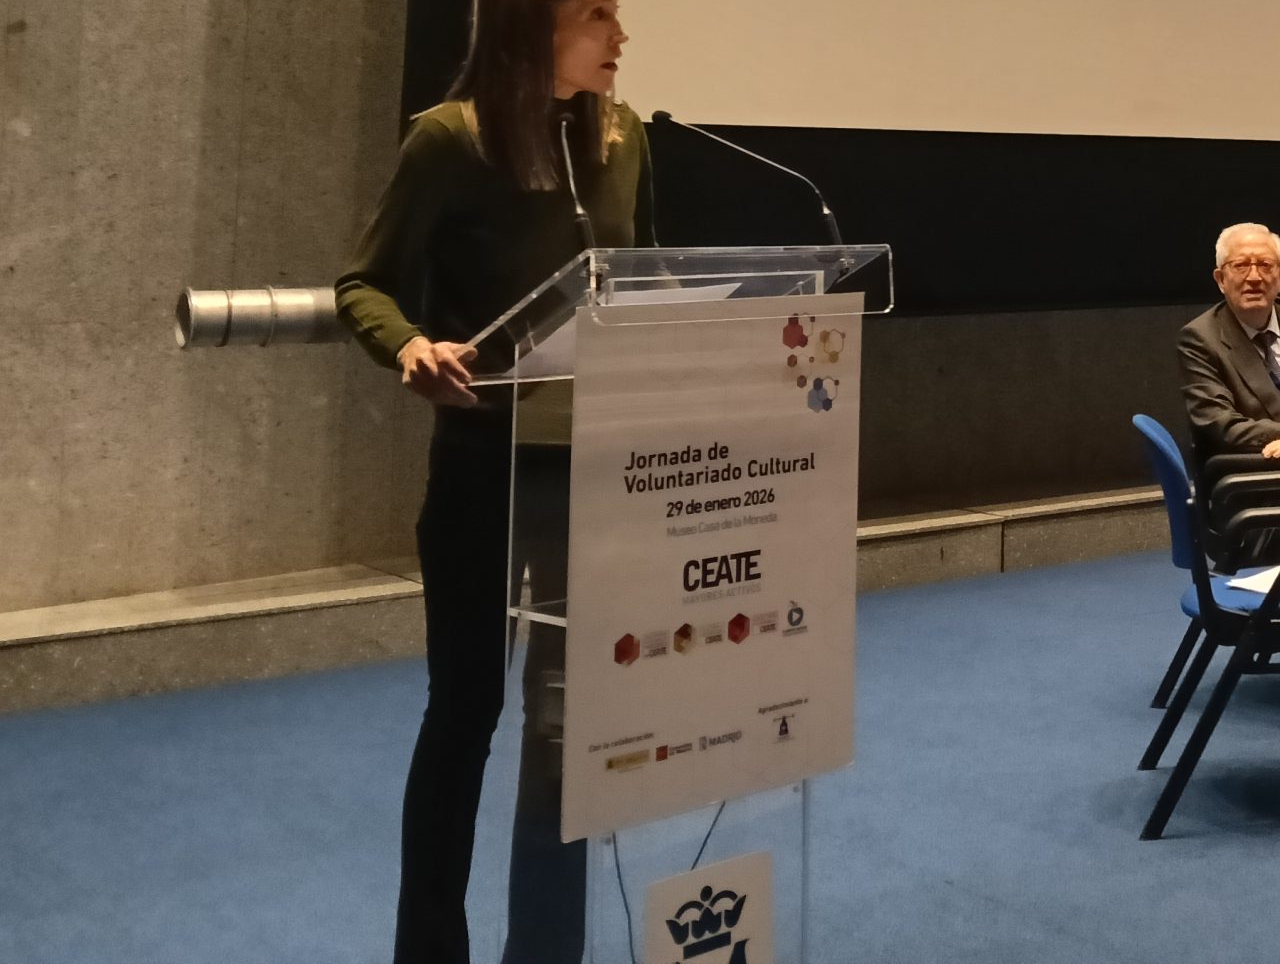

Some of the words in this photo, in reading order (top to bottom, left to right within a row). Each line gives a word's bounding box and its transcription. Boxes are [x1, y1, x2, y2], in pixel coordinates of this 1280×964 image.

[624, 445, 702, 471] Jornada
[707, 442, 729, 461] de
[624, 463, 742, 494] Voluntariado
[747, 452, 816, 479] Cultural
[666, 500, 683, 518] 29
[685, 498, 702, 514] de
[704, 496, 741, 513] enero
[743, 488, 775, 507] 2026
[698, 520, 720, 534] Casa
[721, 518, 732, 530] de
[683, 549, 762, 593] CEATE
[709, 730, 742, 747] MADRID
